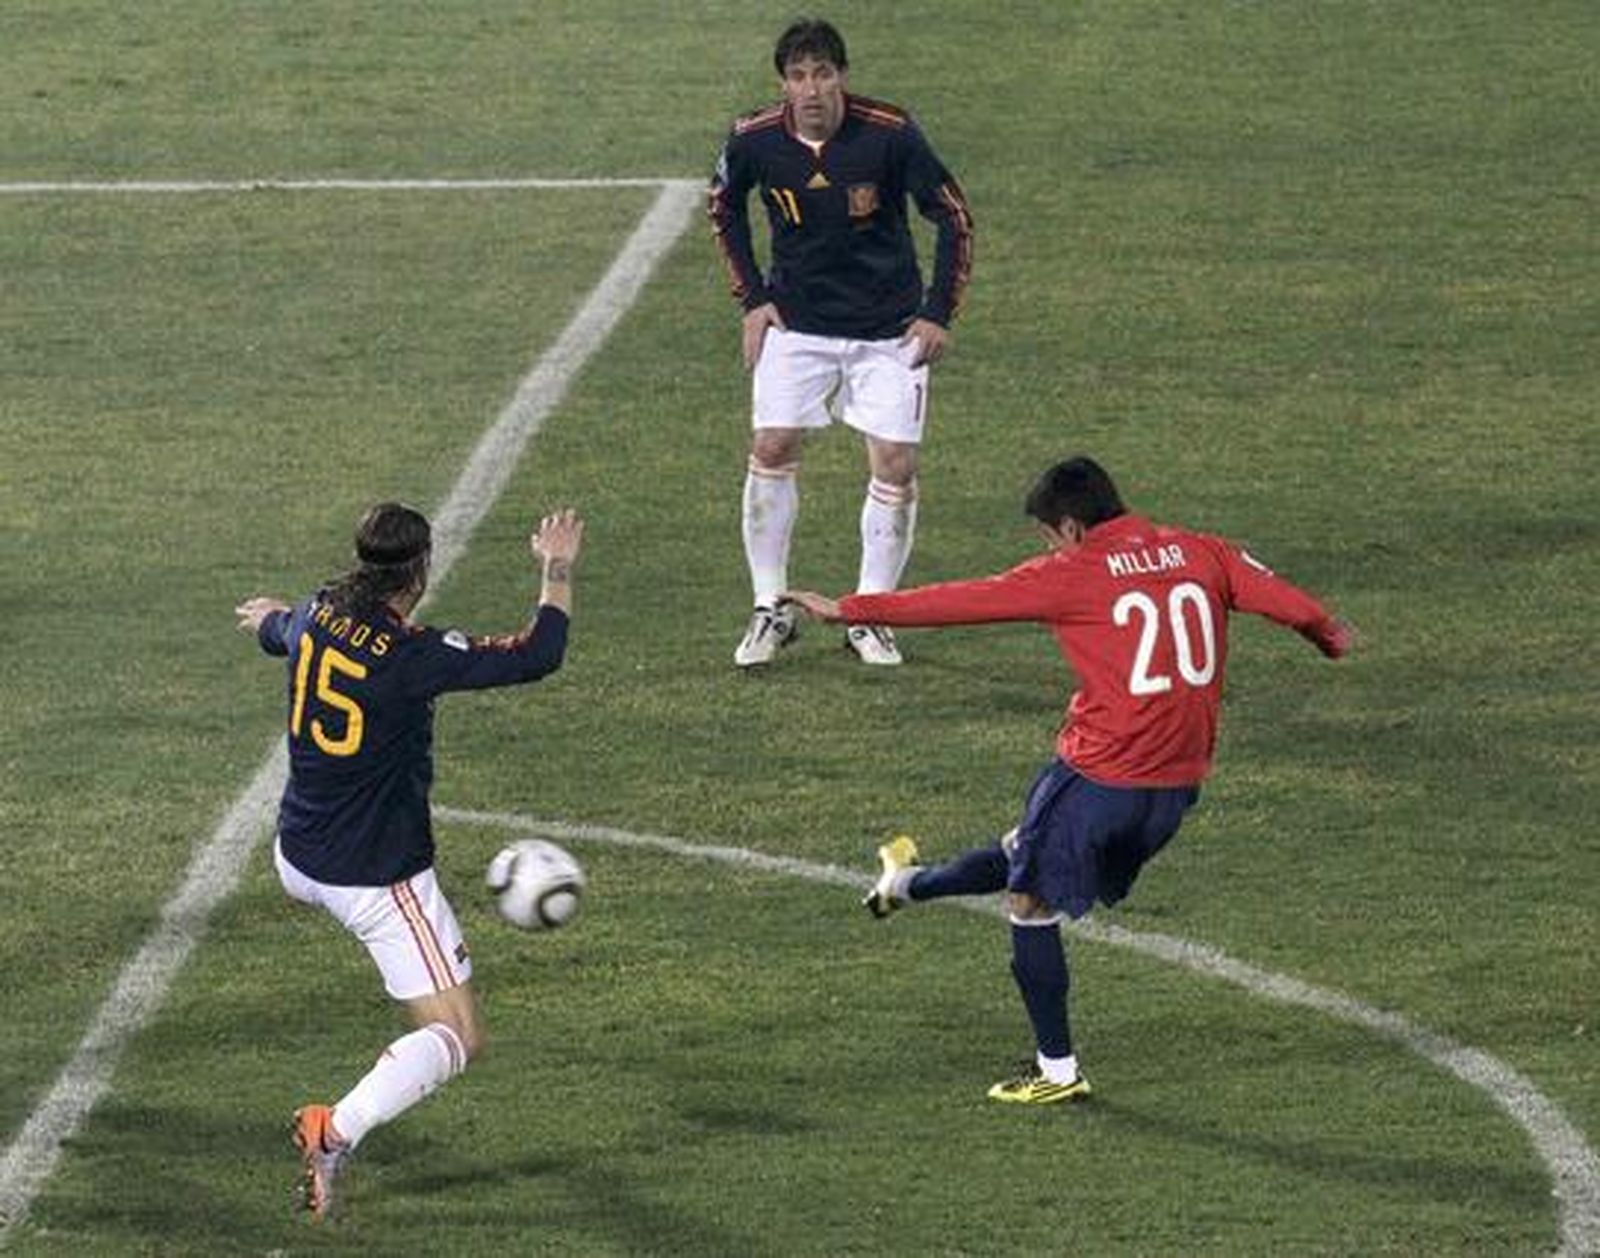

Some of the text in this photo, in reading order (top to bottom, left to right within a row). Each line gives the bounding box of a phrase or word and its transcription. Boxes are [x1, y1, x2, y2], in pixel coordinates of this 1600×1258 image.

[770, 187, 801, 224] 11
[1106, 544, 1186, 577] MILLAR
[1112, 582, 1216, 695] 20
[291, 632, 367, 756] 15
